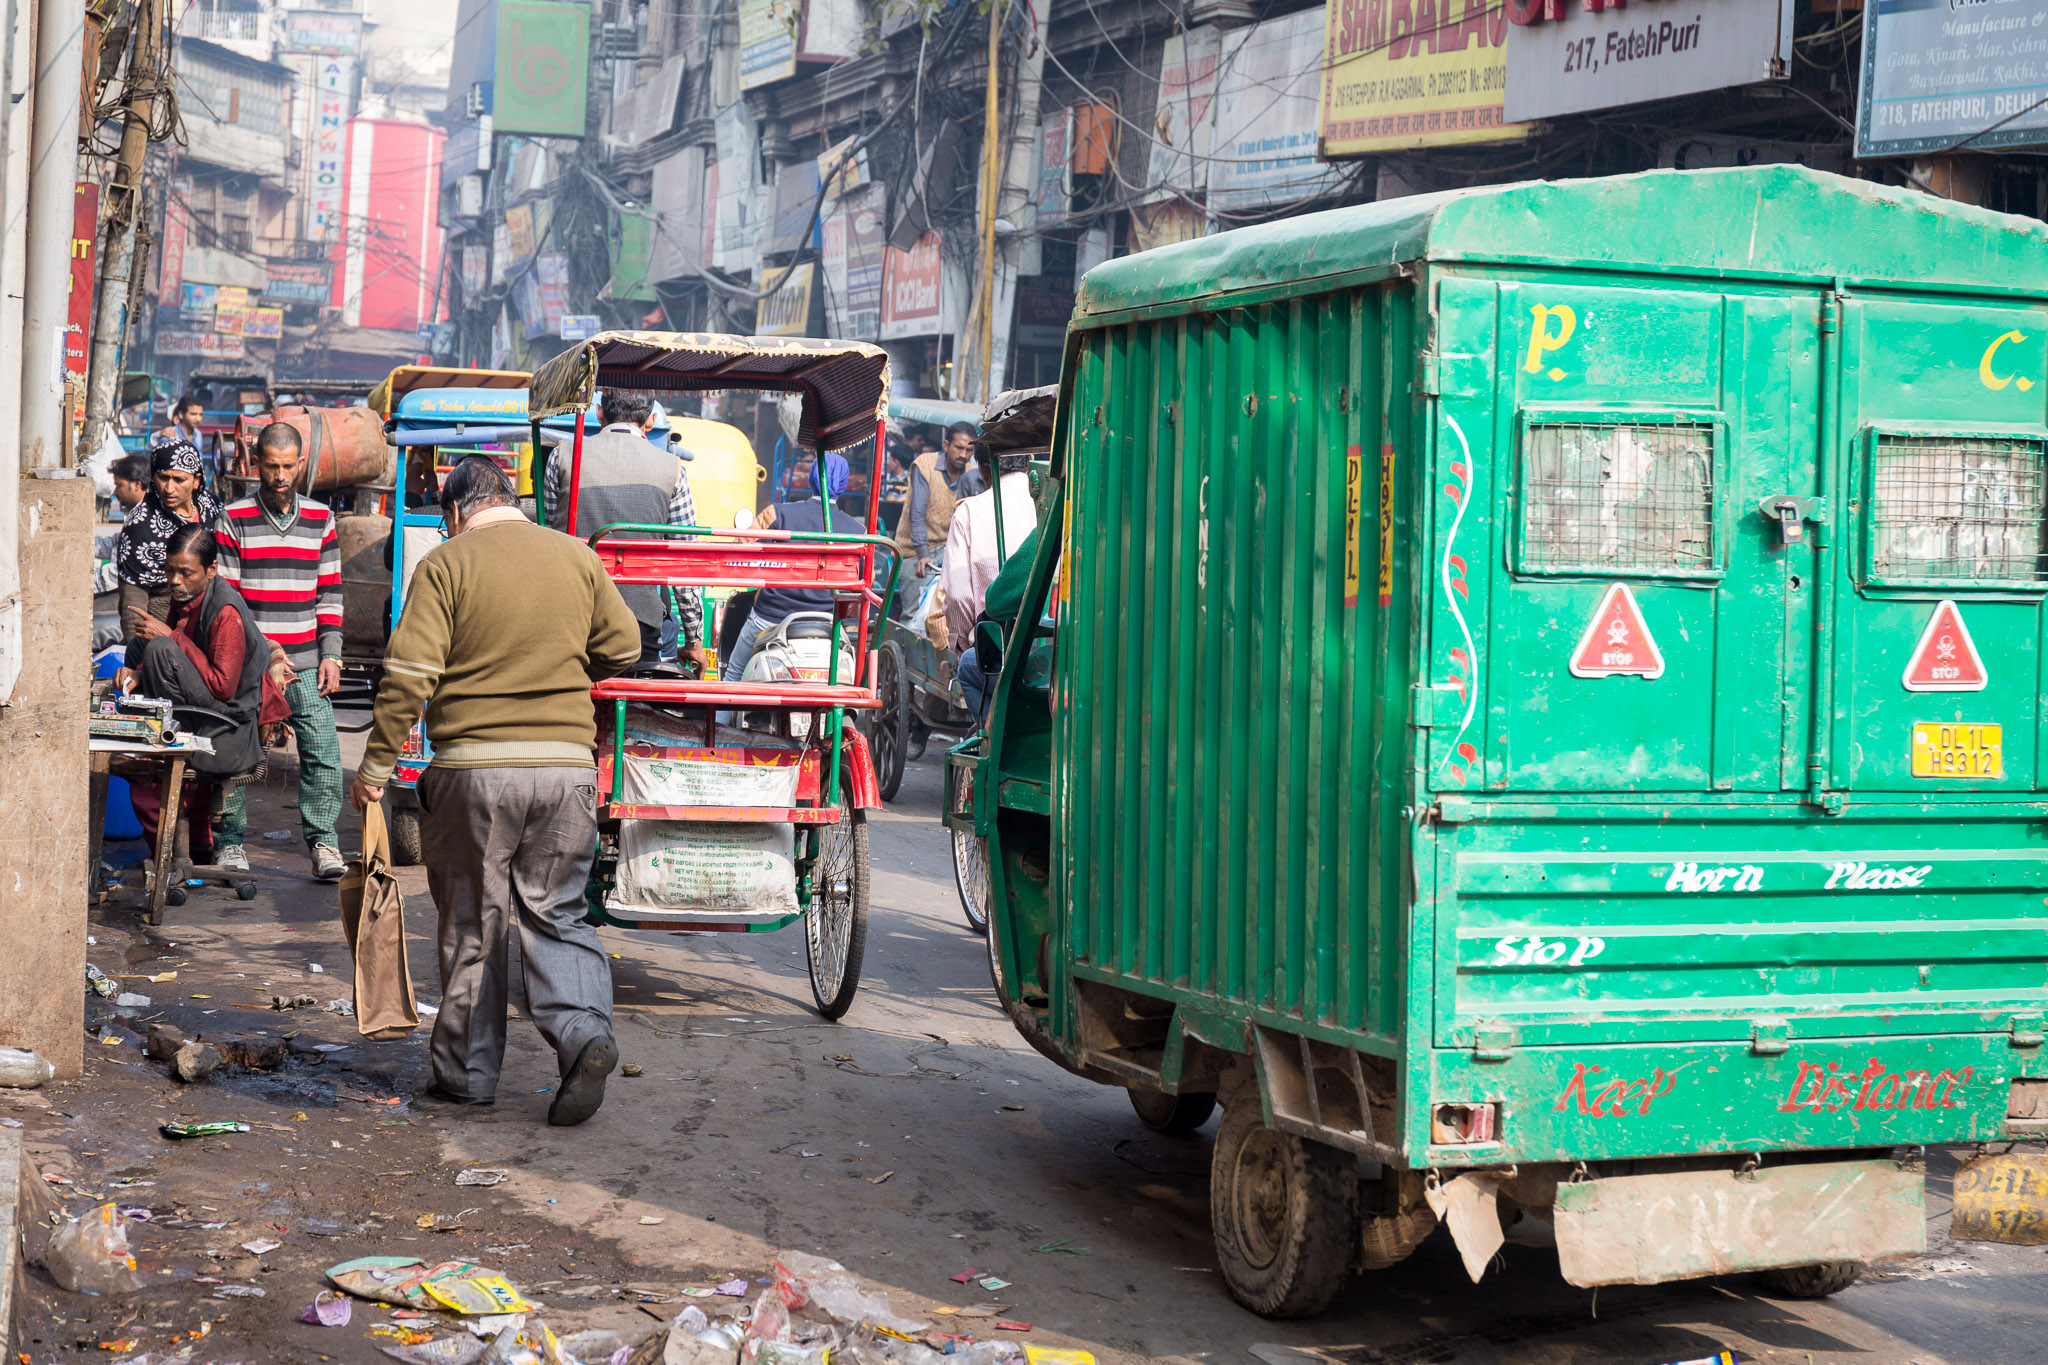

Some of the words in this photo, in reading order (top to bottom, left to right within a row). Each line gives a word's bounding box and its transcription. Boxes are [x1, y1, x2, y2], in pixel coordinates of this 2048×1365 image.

[1340, 0, 1387, 55] SHRI
[1941, 15, 2027, 38] Manufacture
[1564, 36, 1599, 73] 217,
[1605, 15, 1702, 66] FatehPuri
[1887, 52, 1921, 72] Gota,
[1926, 45, 1971, 66] Kinari,
[1975, 40, 2005, 59] Har,
[1347, 80, 1377, 106] FATEHPURI
[1391, 74, 1425, 101] AGGARWAL
[1909, 65, 1990, 90] Bandarwall,
[1993, 62, 2038, 83] Rakhi,
[318, 55, 341, 153] AISHNAW
[1879, 104, 1907, 127] 218,
[1911, 97, 1990, 124] FATEHPURI,
[1326, 124, 1337, 140] राम
[1340, 122, 1351, 138] राम
[1353, 120, 1365, 137] राम
[1368, 119, 1380, 136] राम
[1382, 117, 1394, 135] राम
[1397, 116, 1410, 133] राम
[1412, 114, 1425, 132] राम
[1428, 112, 1441, 130] राम
[1445, 111, 1458, 129] राम
[1461, 109, 1475, 127] राम
[1478, 107, 1492, 126] राम
[317, 161, 337, 225] HOTEL
[1520, 303, 1577, 382] P.
[1979, 329, 2037, 393] C.
[1198, 475, 1210, 590] CNG
[1601, 652, 1635, 666] STOP
[1931, 667, 1961, 680] STOP
[1931, 751, 1992, 774] H9312
[1664, 861, 1765, 893] Horn
[1823, 861, 1934, 891] Please
[1494, 934, 1606, 967] Stop
[1553, 1060, 1678, 1119] Keep
[1777, 1056, 1976, 1115] Distance
